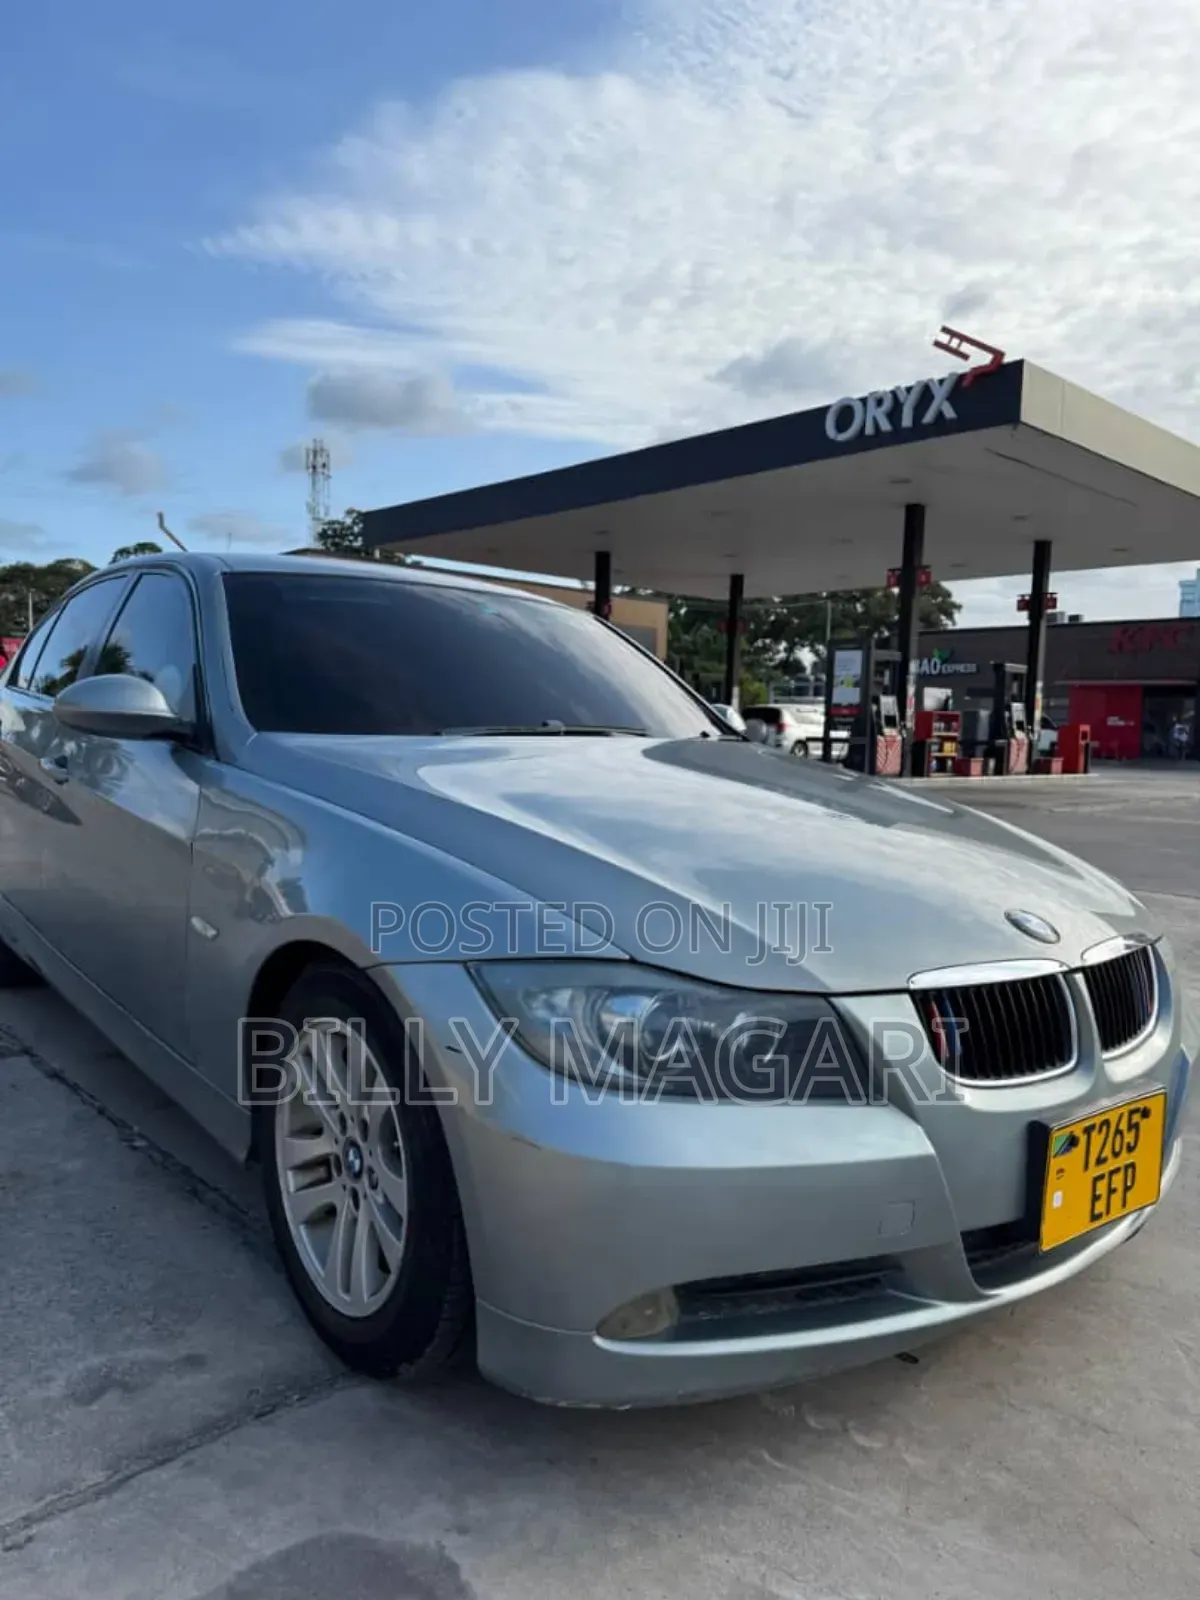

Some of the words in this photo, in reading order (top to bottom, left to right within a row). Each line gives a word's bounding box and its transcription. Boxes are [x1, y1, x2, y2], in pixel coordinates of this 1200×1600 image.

[824, 372, 960, 442] ORYX
[1082, 1107, 1141, 1173] T265
[1089, 1161, 1137, 1223] EFP
